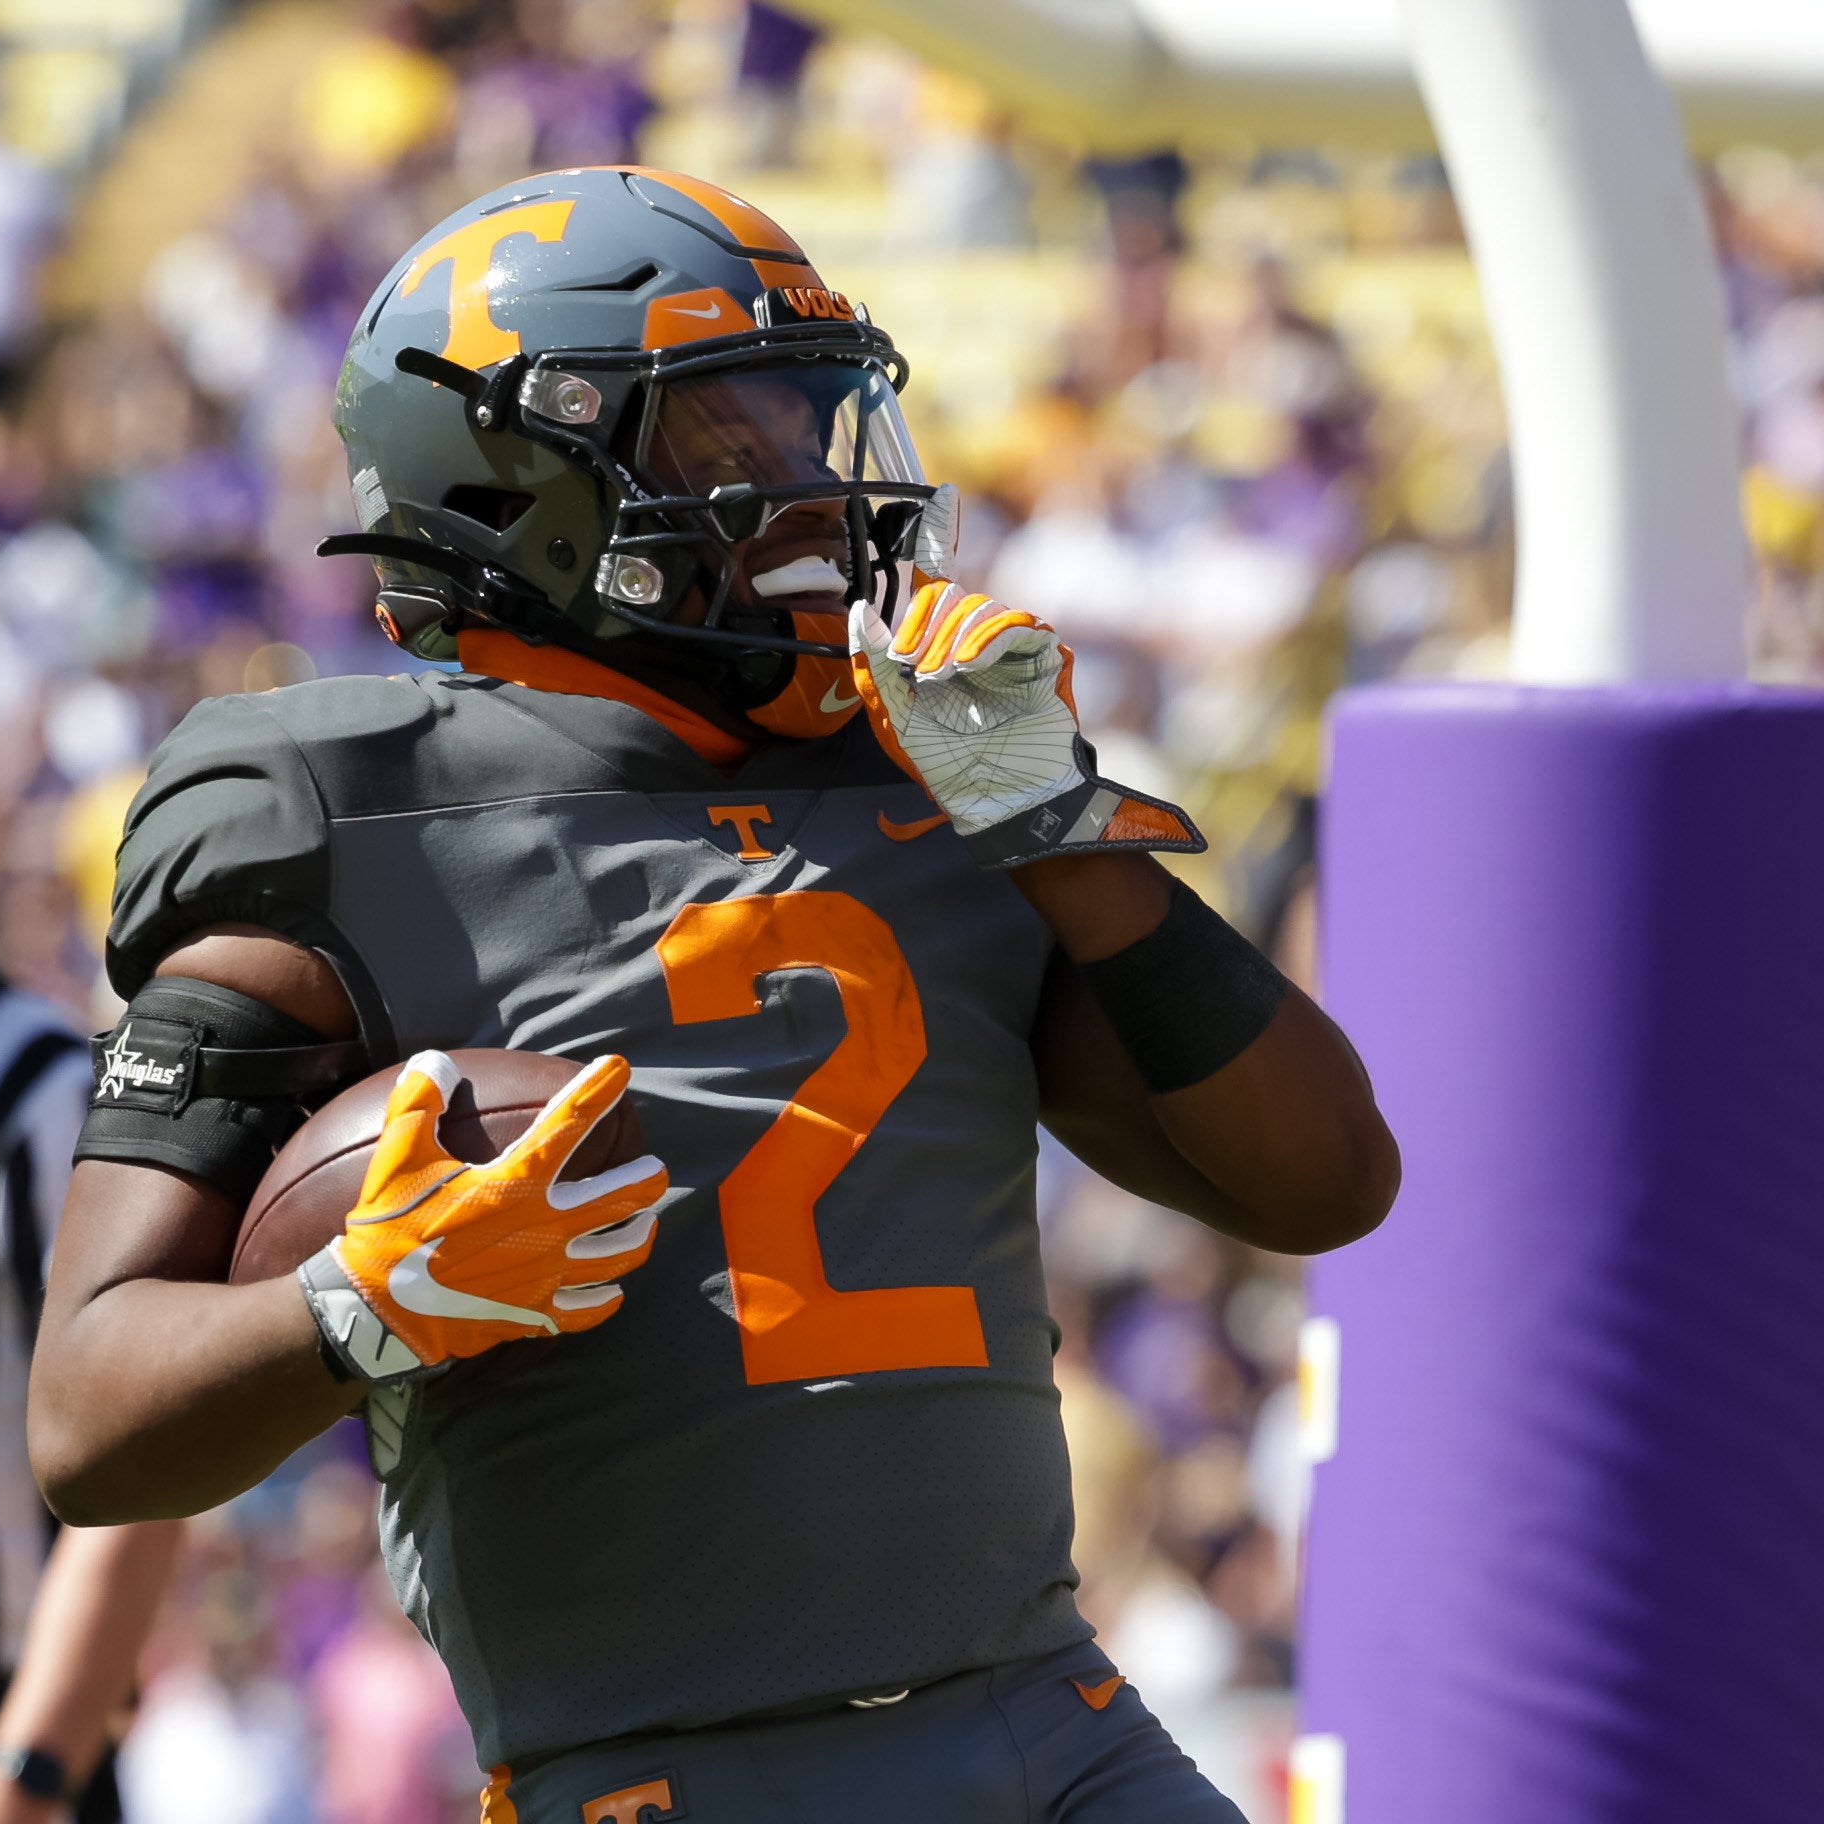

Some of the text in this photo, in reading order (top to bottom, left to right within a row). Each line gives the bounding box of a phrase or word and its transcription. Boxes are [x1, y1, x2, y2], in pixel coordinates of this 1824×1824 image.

[401, 199, 576, 371] T
[783, 287, 856, 321] VOLS
[707, 804, 774, 860] T
[107, 1052, 177, 1087] Douglas
[655, 889, 990, 1385] 2
